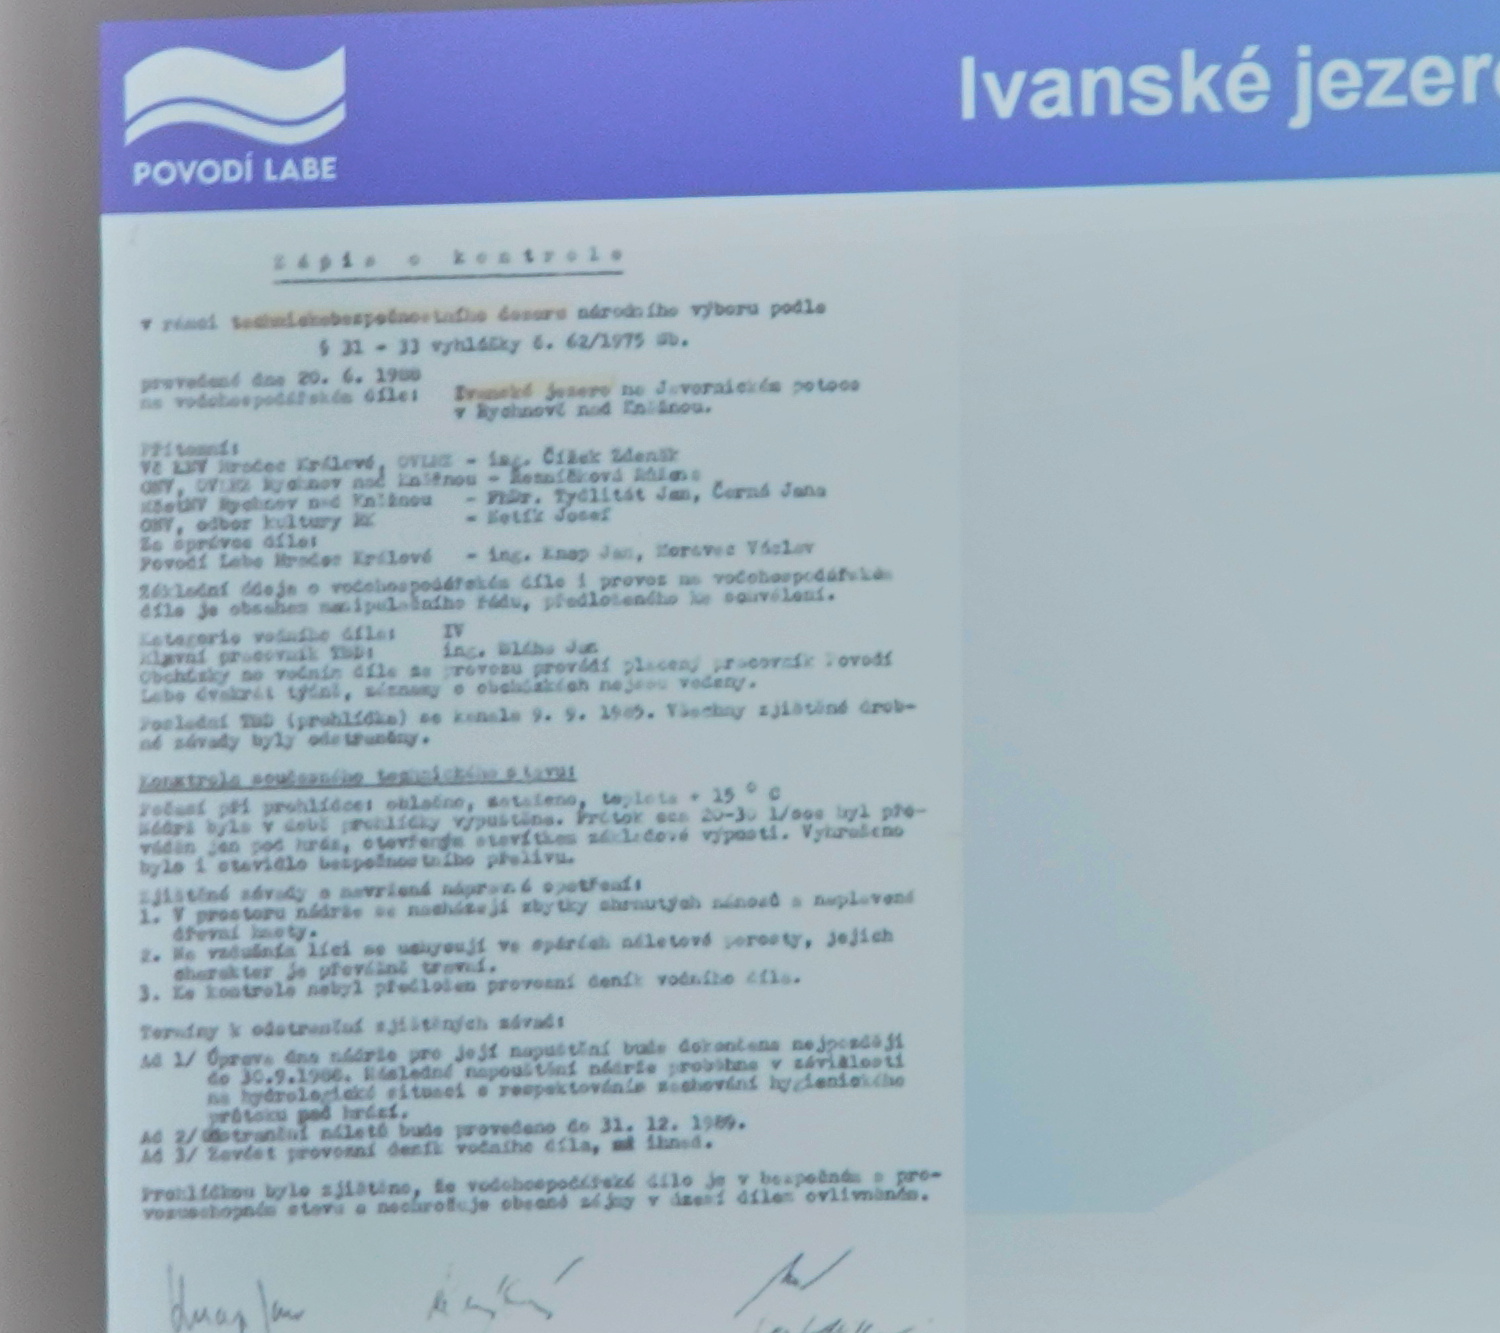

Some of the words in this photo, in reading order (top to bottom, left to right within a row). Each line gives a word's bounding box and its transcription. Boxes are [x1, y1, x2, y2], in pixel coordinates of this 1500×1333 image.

[958, 46, 1273, 120] Ivanské
[133, 151, 254, 187] POVODÍ
[264, 156, 337, 183] LABE
